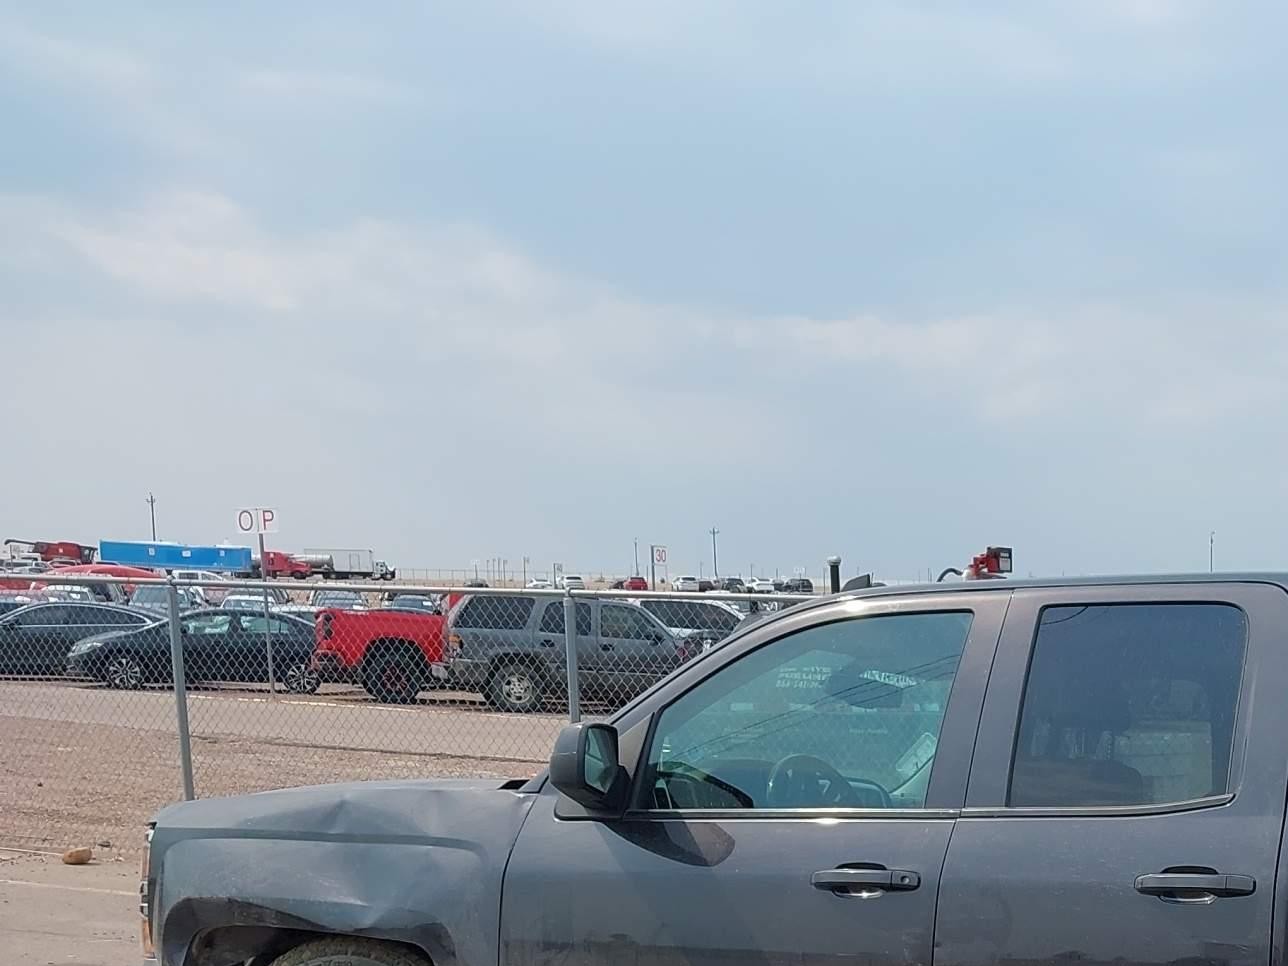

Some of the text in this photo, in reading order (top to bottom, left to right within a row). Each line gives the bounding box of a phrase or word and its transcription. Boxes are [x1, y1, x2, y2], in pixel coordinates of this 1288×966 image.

[238, 510, 275, 532] O P
[655, 548, 667, 562] 30
